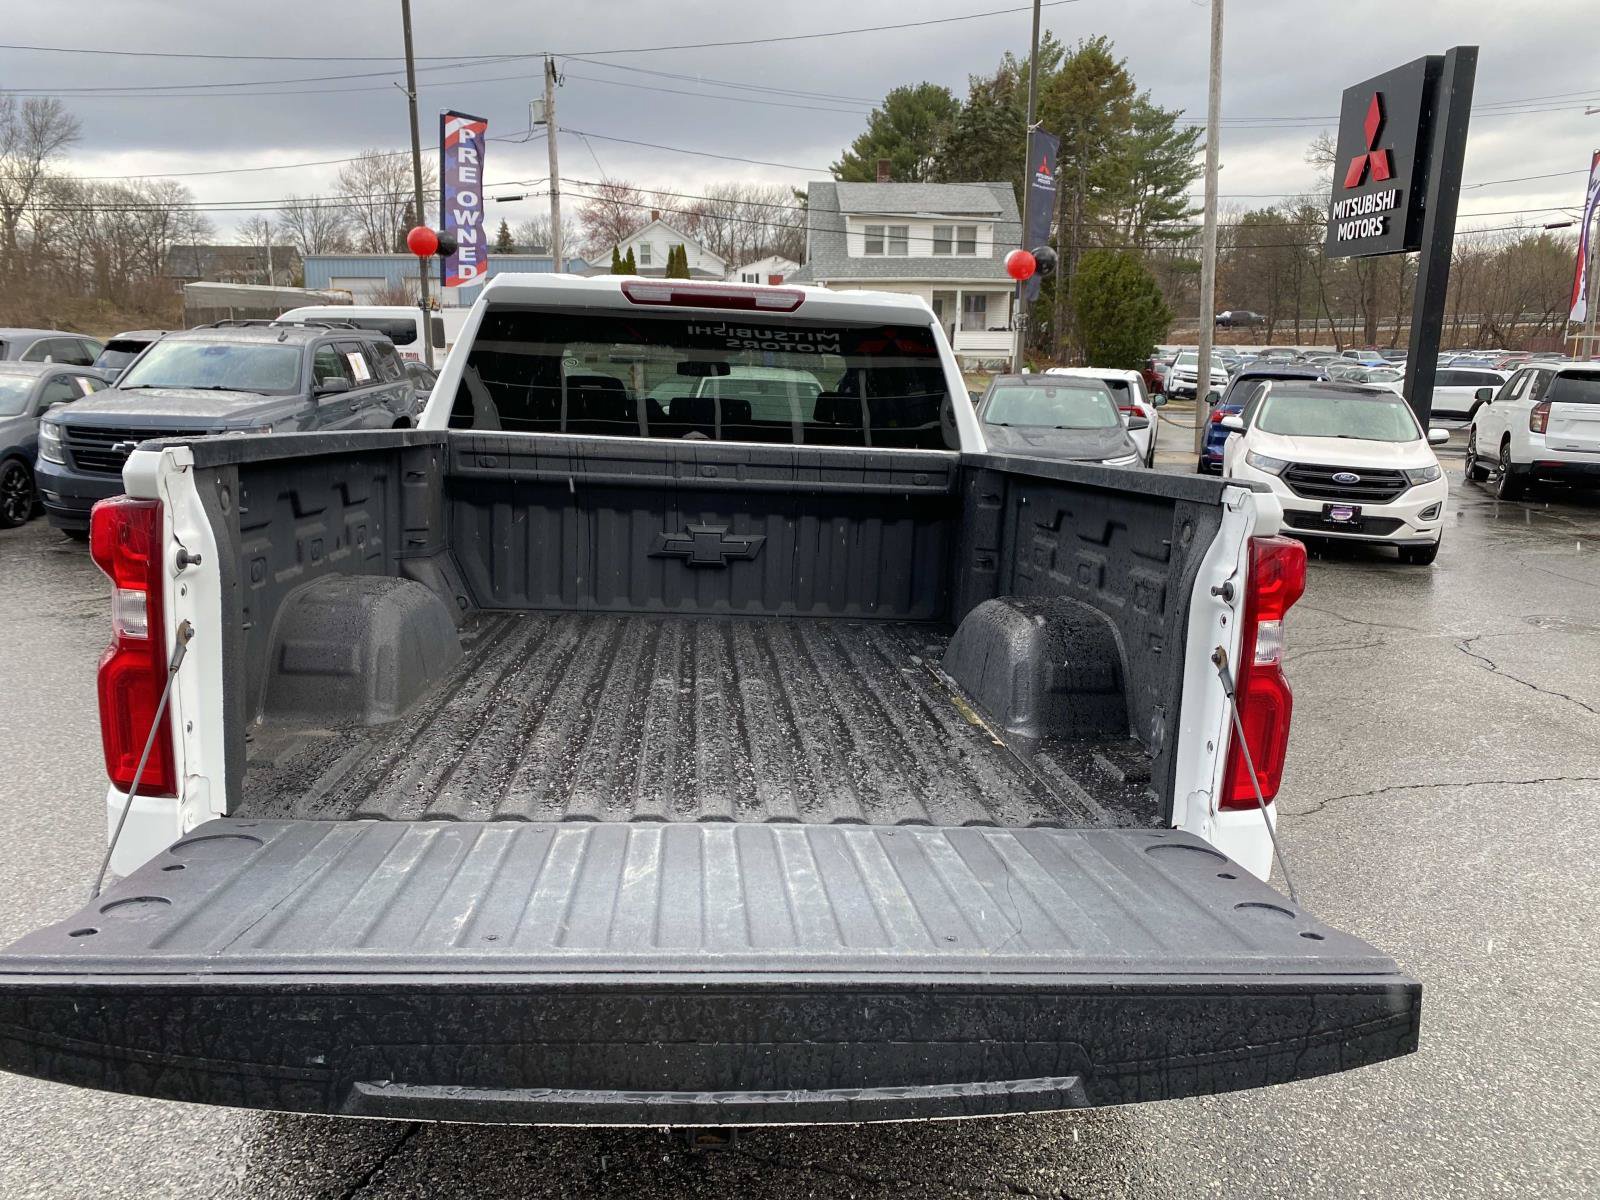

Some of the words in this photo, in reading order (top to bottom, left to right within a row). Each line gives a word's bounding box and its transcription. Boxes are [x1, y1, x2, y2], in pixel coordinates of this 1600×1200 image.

[457, 128, 479, 184] PRE
[1332, 188, 1396, 220] MITSUBISHI
[453, 190, 480, 280] OWNED
[1337, 215, 1384, 242] MOTORS
